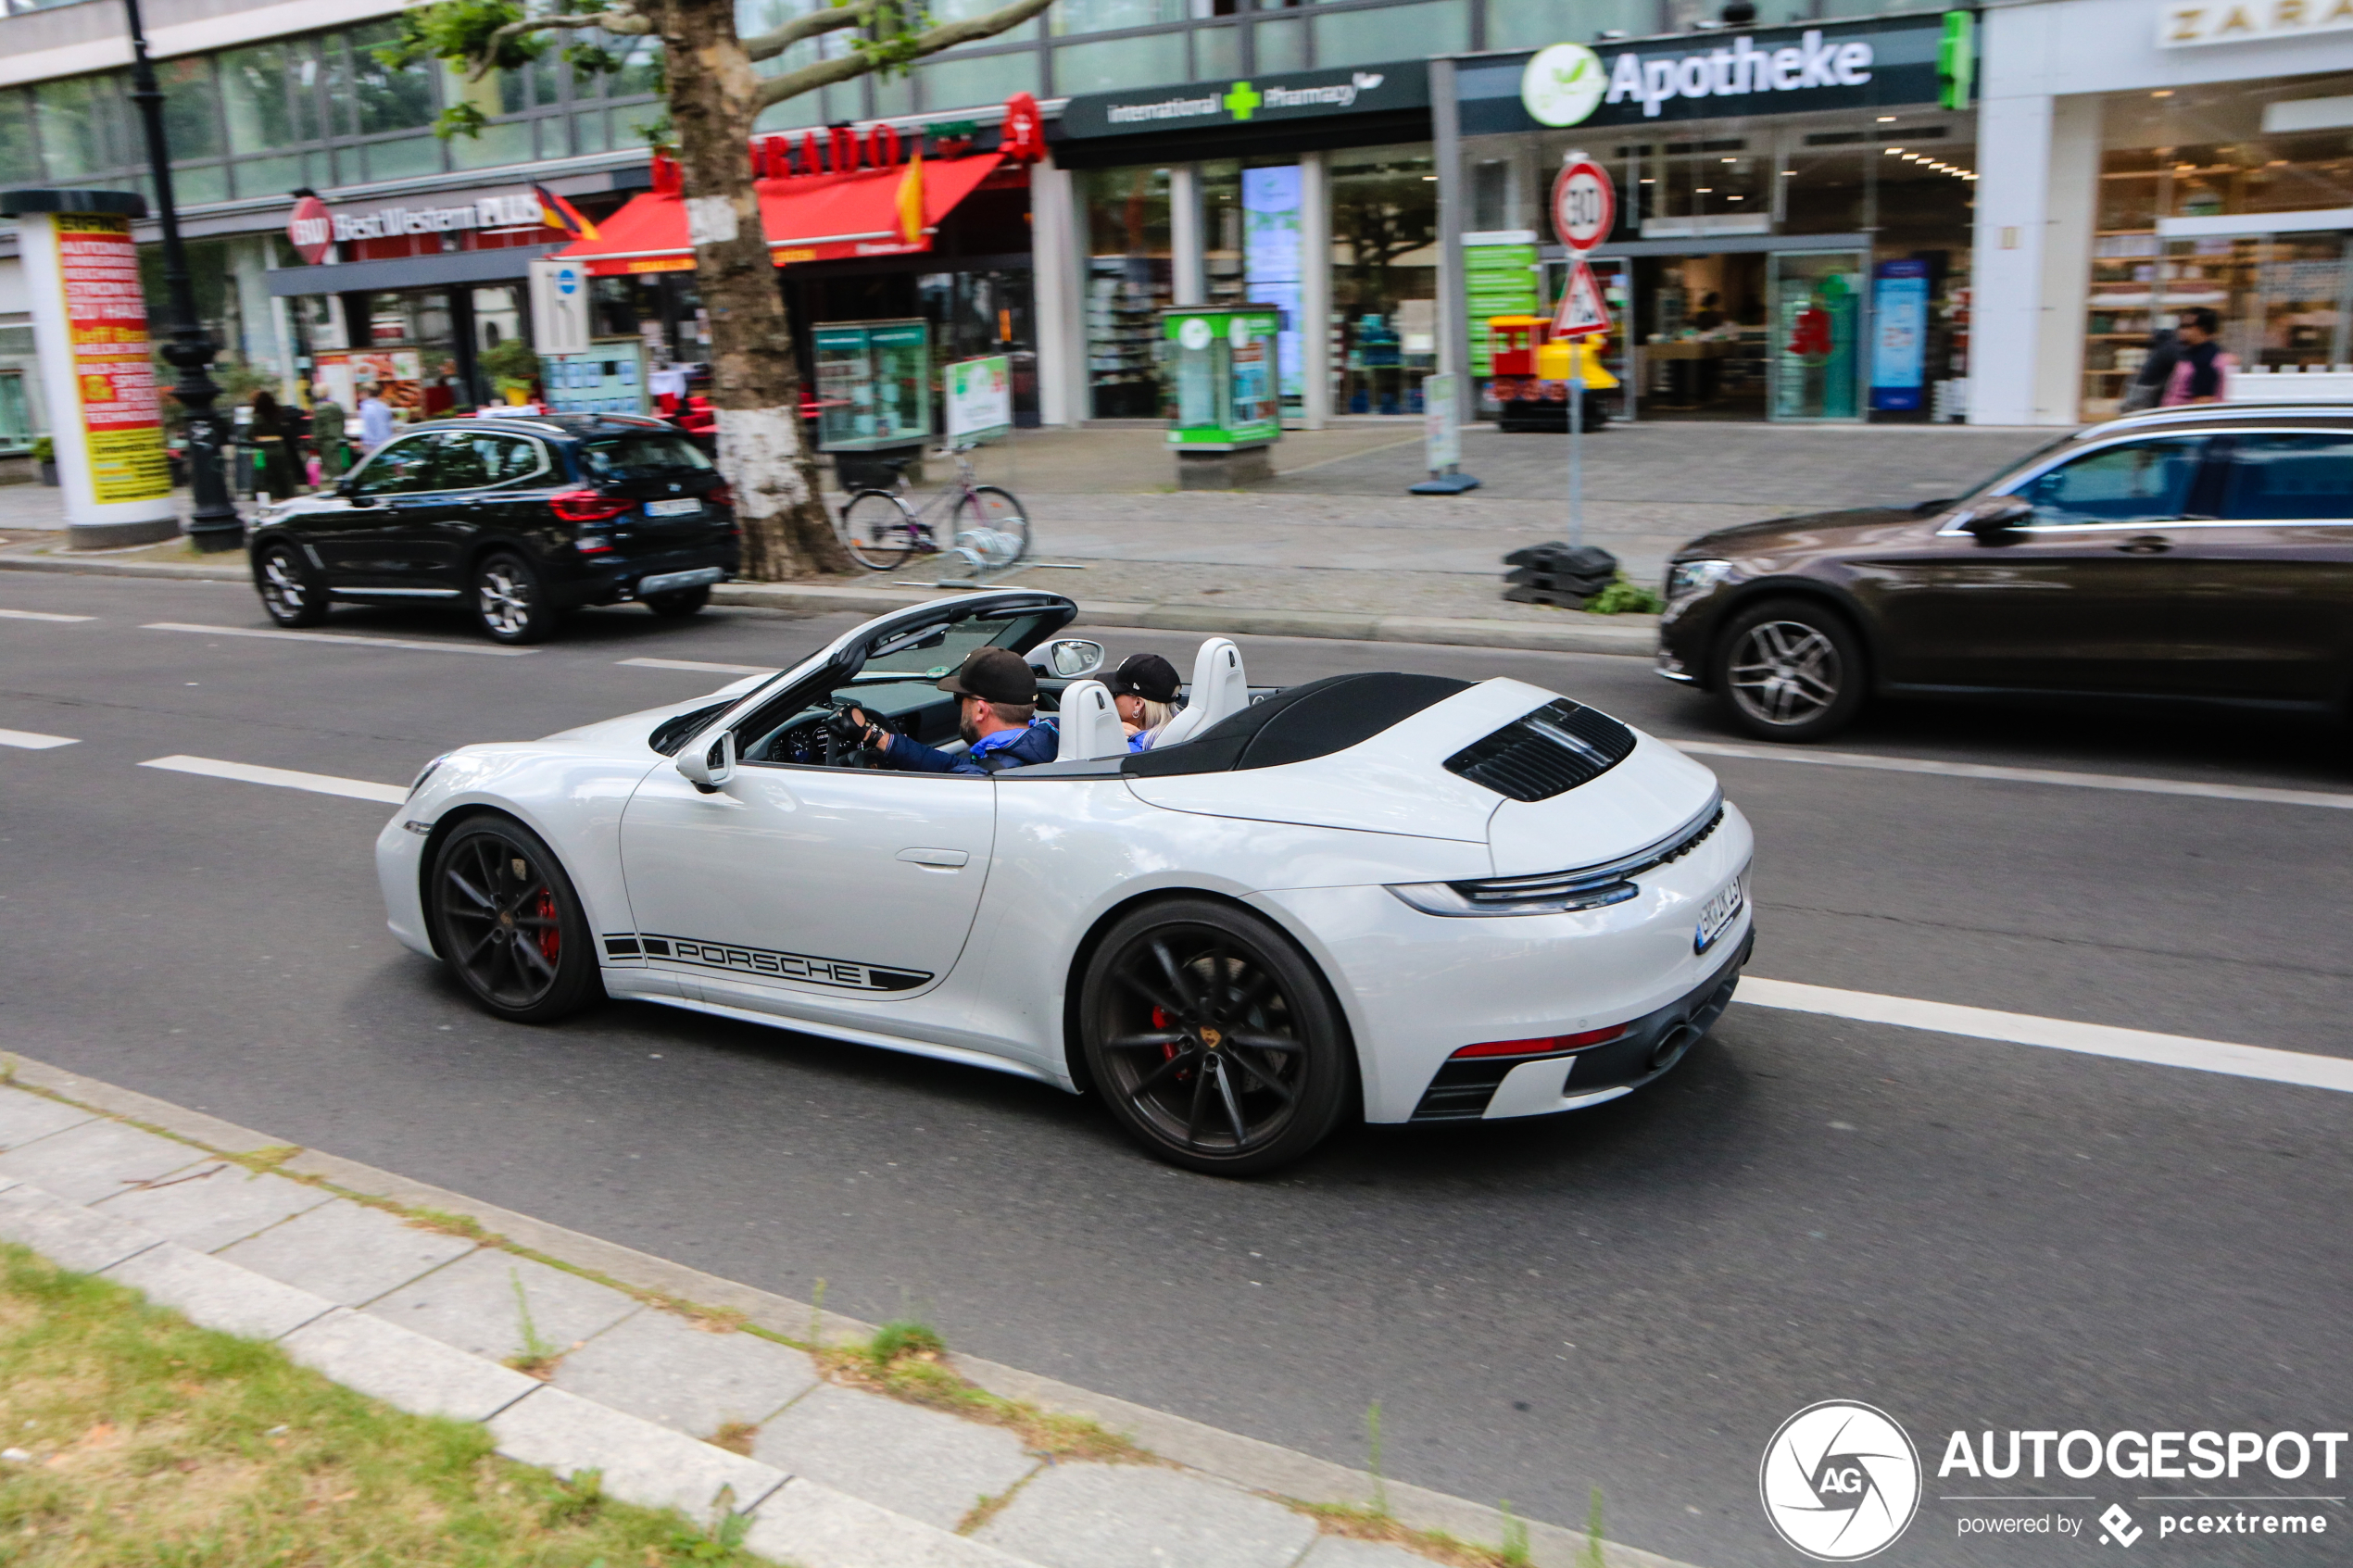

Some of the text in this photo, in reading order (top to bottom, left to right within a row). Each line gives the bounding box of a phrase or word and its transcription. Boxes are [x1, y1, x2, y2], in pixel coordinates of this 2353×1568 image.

[1605, 30, 1874, 117] Apotheke
[1264, 86, 1359, 107] Pharmacy
[333, 212, 383, 242] Best
[381, 206, 477, 237] Western
[1564, 186, 1599, 226] 30
[674, 942, 862, 984] PORSCHE
